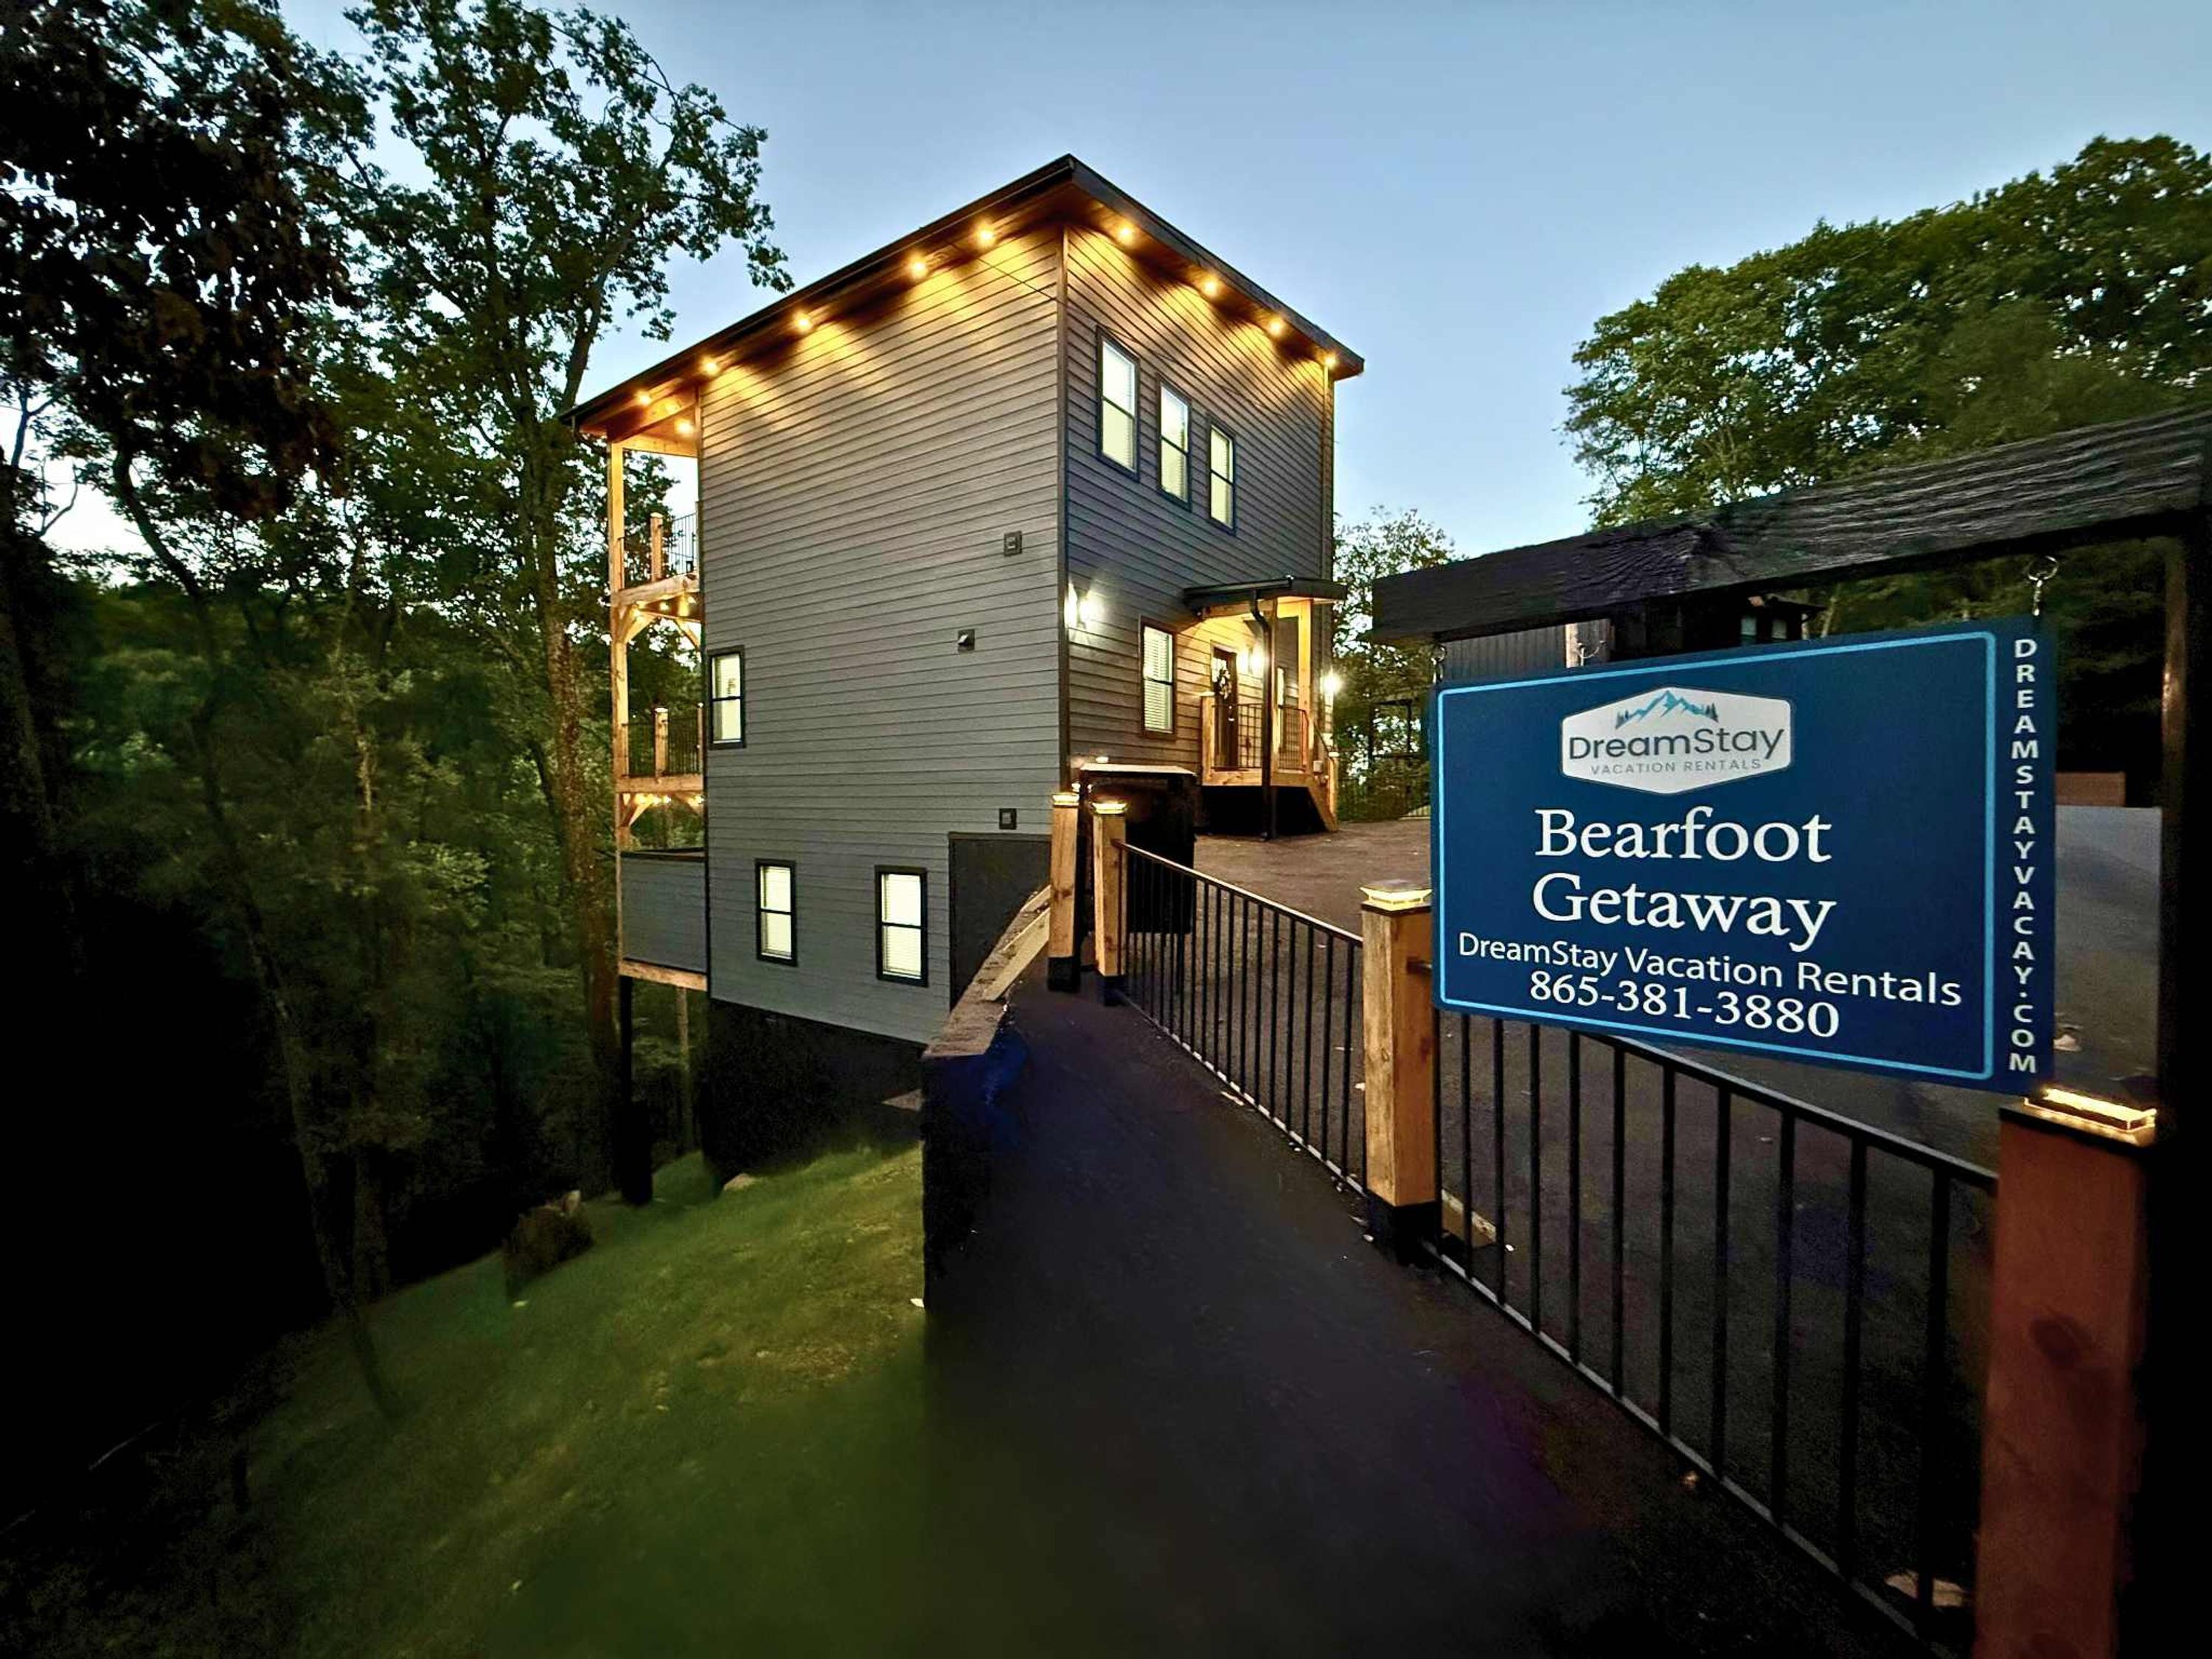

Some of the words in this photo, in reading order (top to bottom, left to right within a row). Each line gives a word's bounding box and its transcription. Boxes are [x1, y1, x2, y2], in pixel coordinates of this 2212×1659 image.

[1568, 728, 1785, 760] DreamStay
[1590, 762, 1676, 776] VACATION
[1683, 758, 1761, 773] RENTALS
[1534, 805, 1833, 863] Bearfoot
[2009, 639, 2039, 1074] DREAMSTAYVACAY.COM
[1532, 872, 1838, 953] Getaway
[1458, 932, 1618, 977] DreamStay
[1624, 946, 1783, 988] Vacation
[1797, 961, 1962, 1006] Rentals
[1529, 970, 1840, 1037] 865-381-3880
